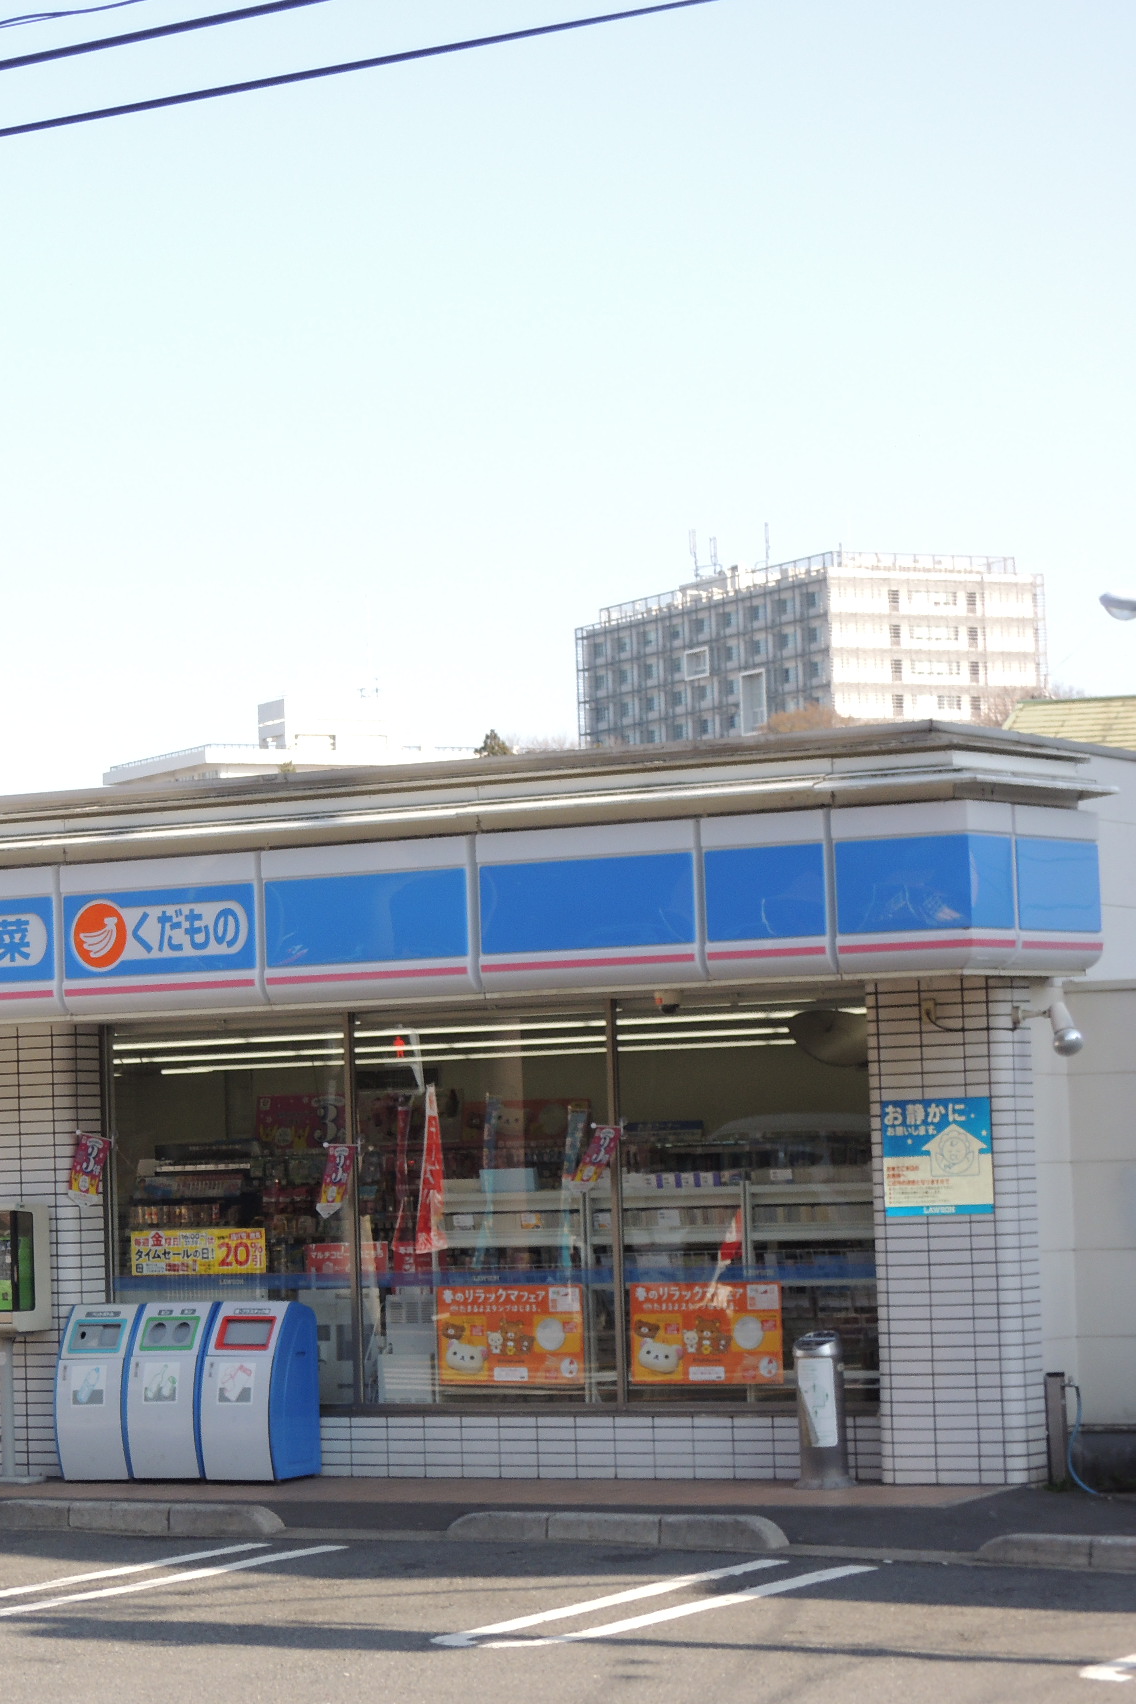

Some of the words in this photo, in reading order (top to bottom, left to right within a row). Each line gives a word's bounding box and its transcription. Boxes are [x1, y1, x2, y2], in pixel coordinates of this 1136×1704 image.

[130, 907, 241, 955] くだもの
[884, 1103, 967, 1125] お静かに
[443, 1288, 546, 1304] 春のリラックマフェア
